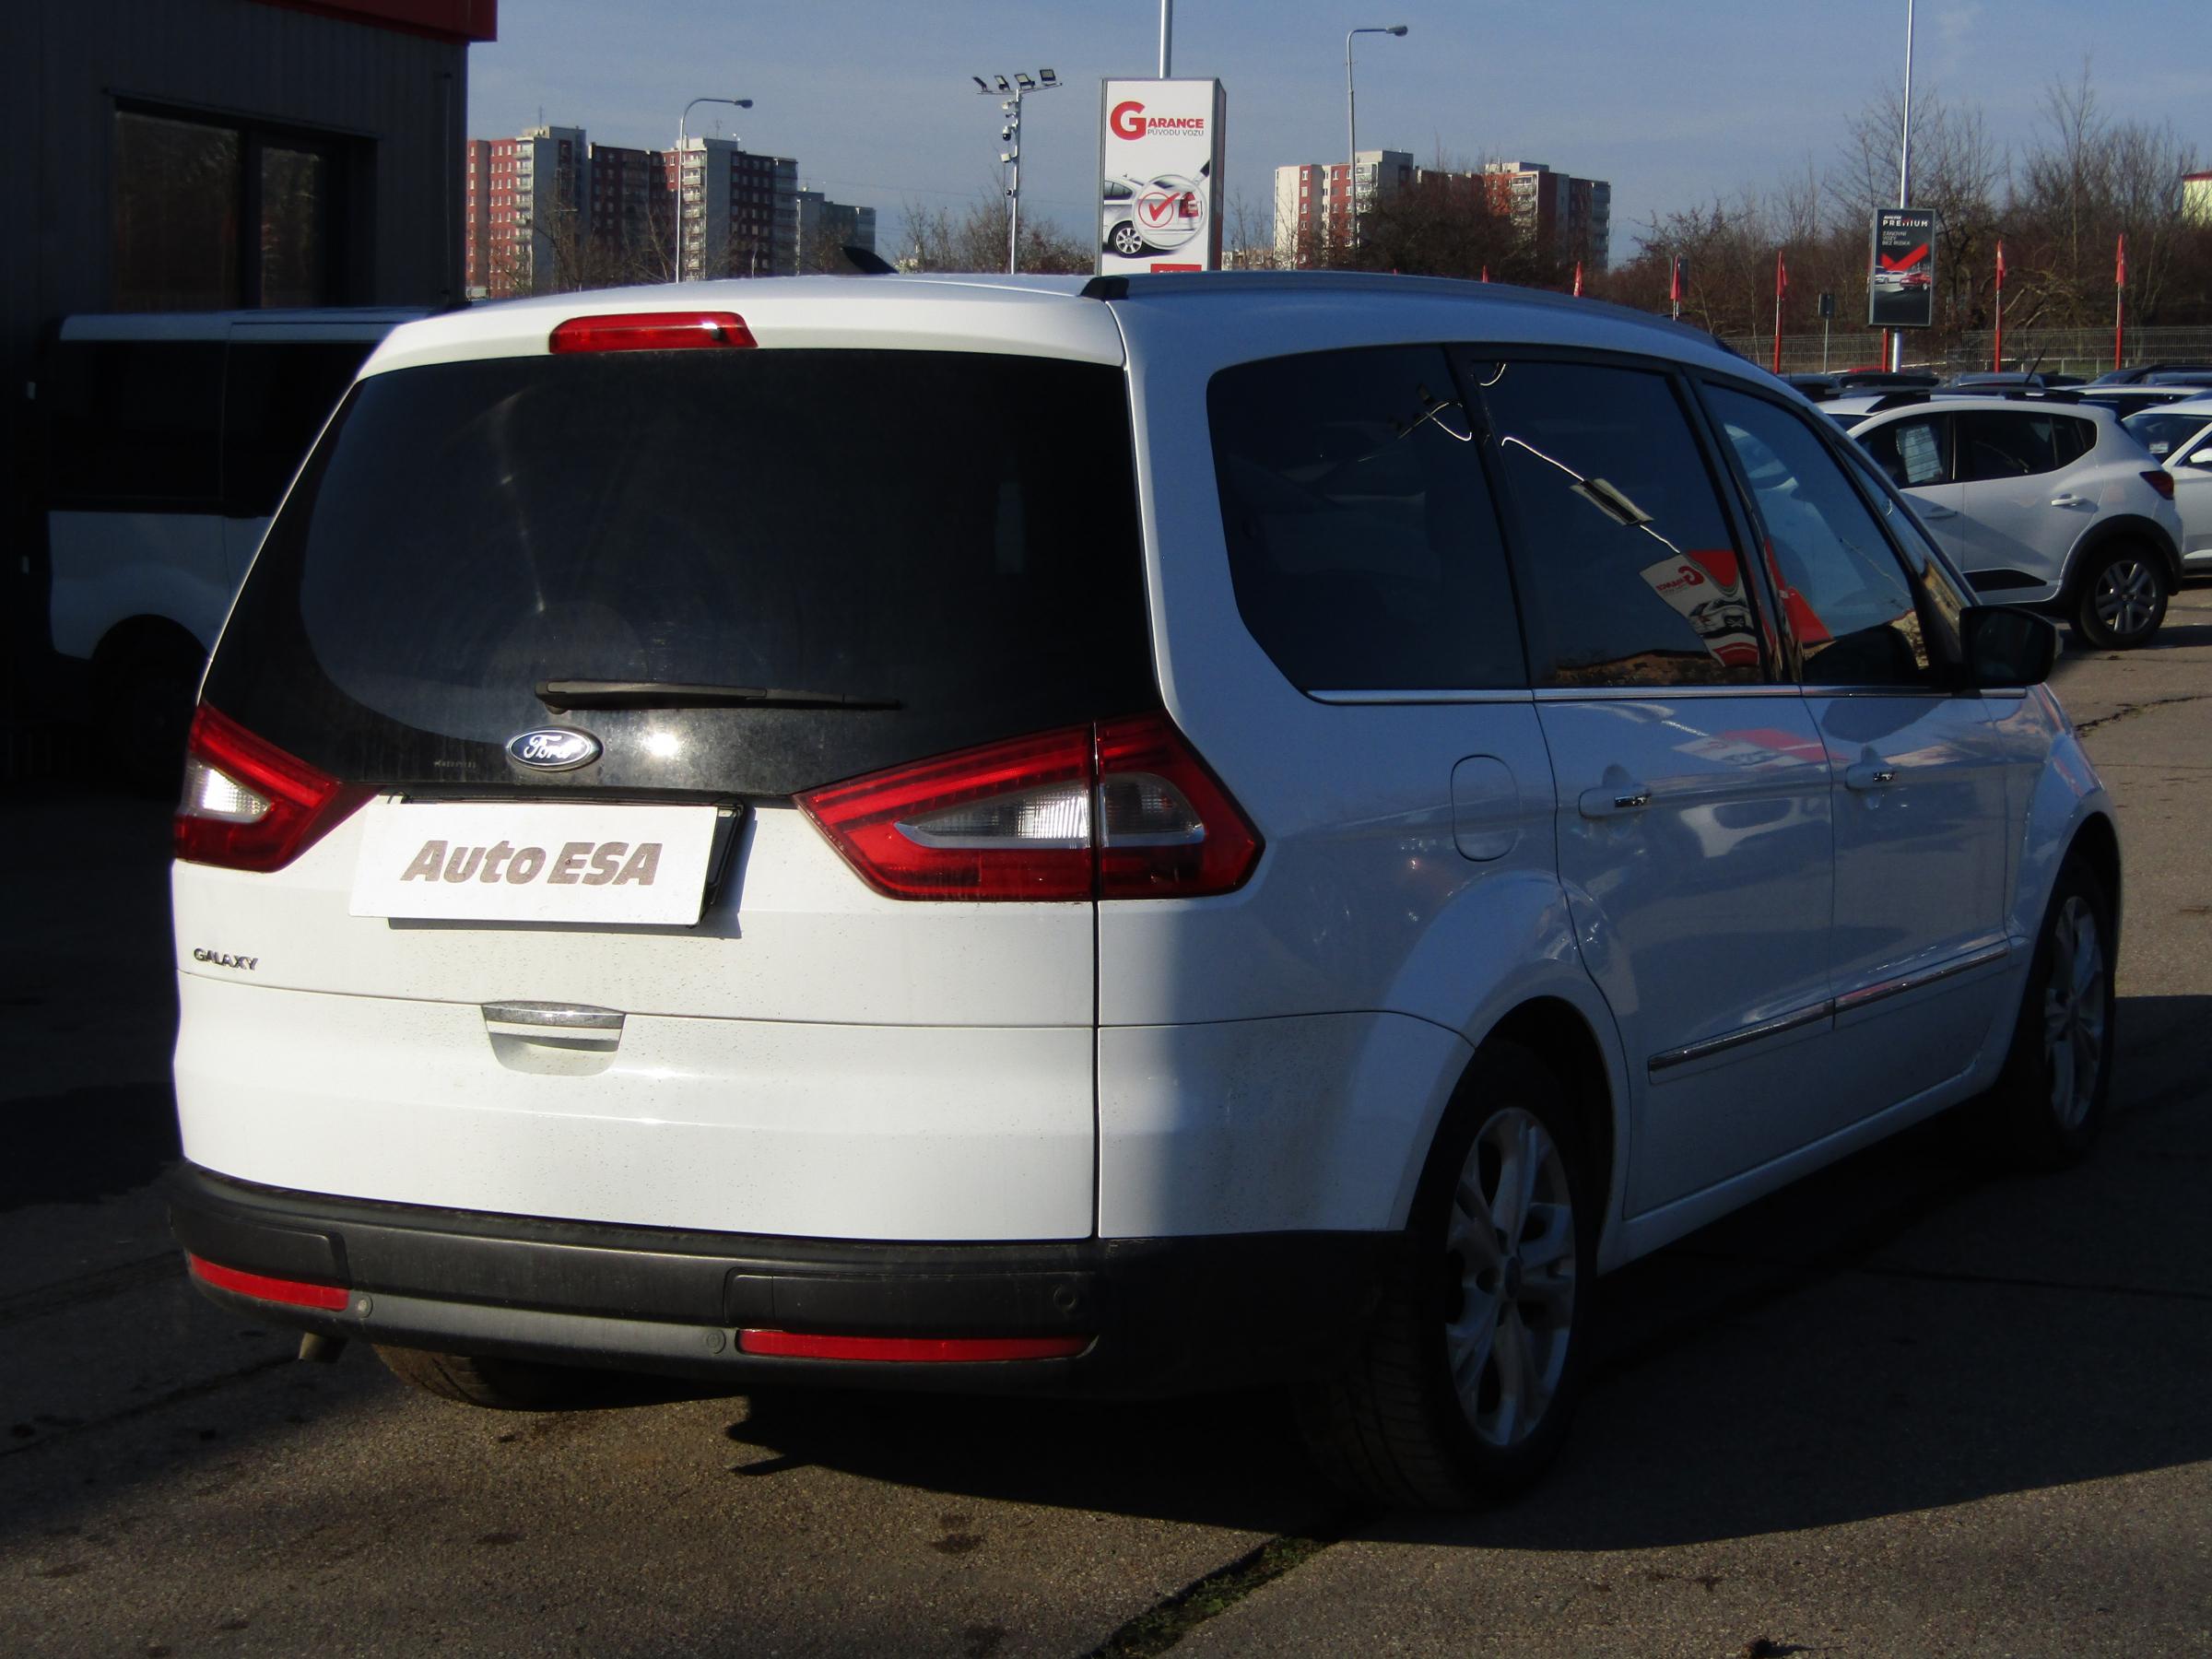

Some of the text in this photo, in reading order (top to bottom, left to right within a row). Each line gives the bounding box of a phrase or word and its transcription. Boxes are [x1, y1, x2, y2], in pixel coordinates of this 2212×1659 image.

[1110, 100, 1204, 140] GARANCE
[523, 734, 584, 759] Ford
[400, 840, 663, 886] Auto ESA
[194, 947, 259, 971] GALAXY
